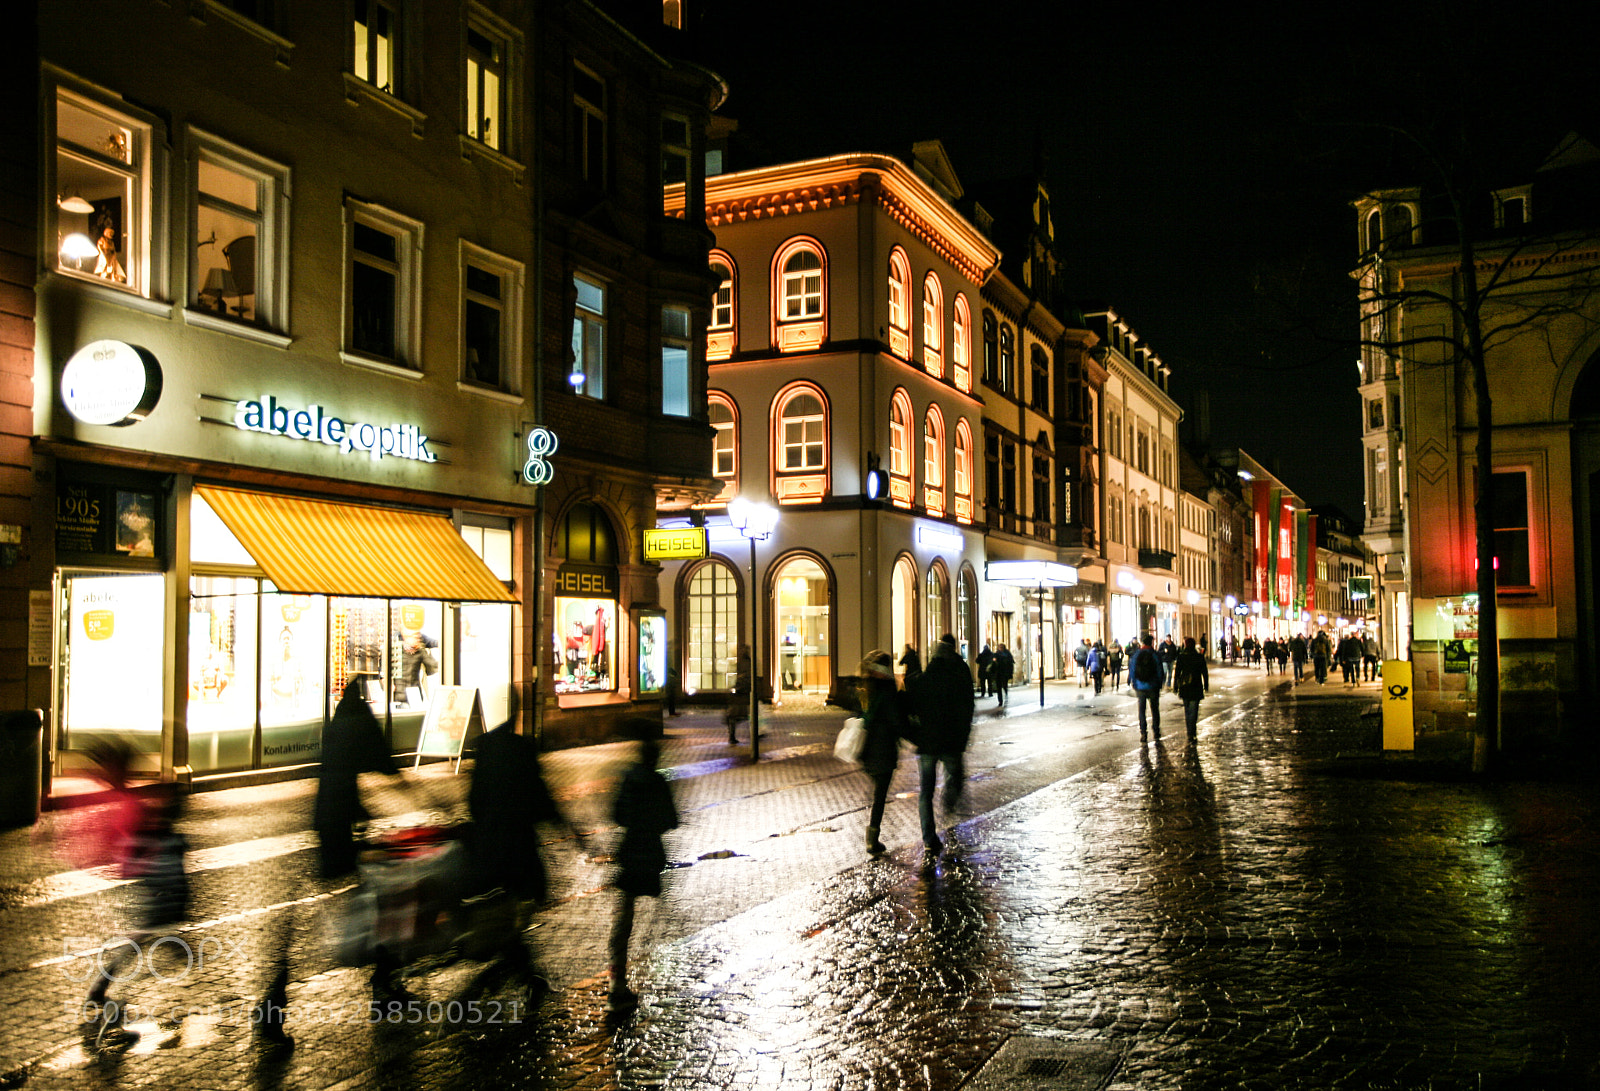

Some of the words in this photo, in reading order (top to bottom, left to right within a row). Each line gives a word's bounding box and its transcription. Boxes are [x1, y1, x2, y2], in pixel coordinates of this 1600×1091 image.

[56, 496, 100, 518] 1905
[648, 538, 702, 552] HEISEL
[555, 572, 612, 593] HEISEL
[264, 742, 320, 756] Kontaktlinsen
